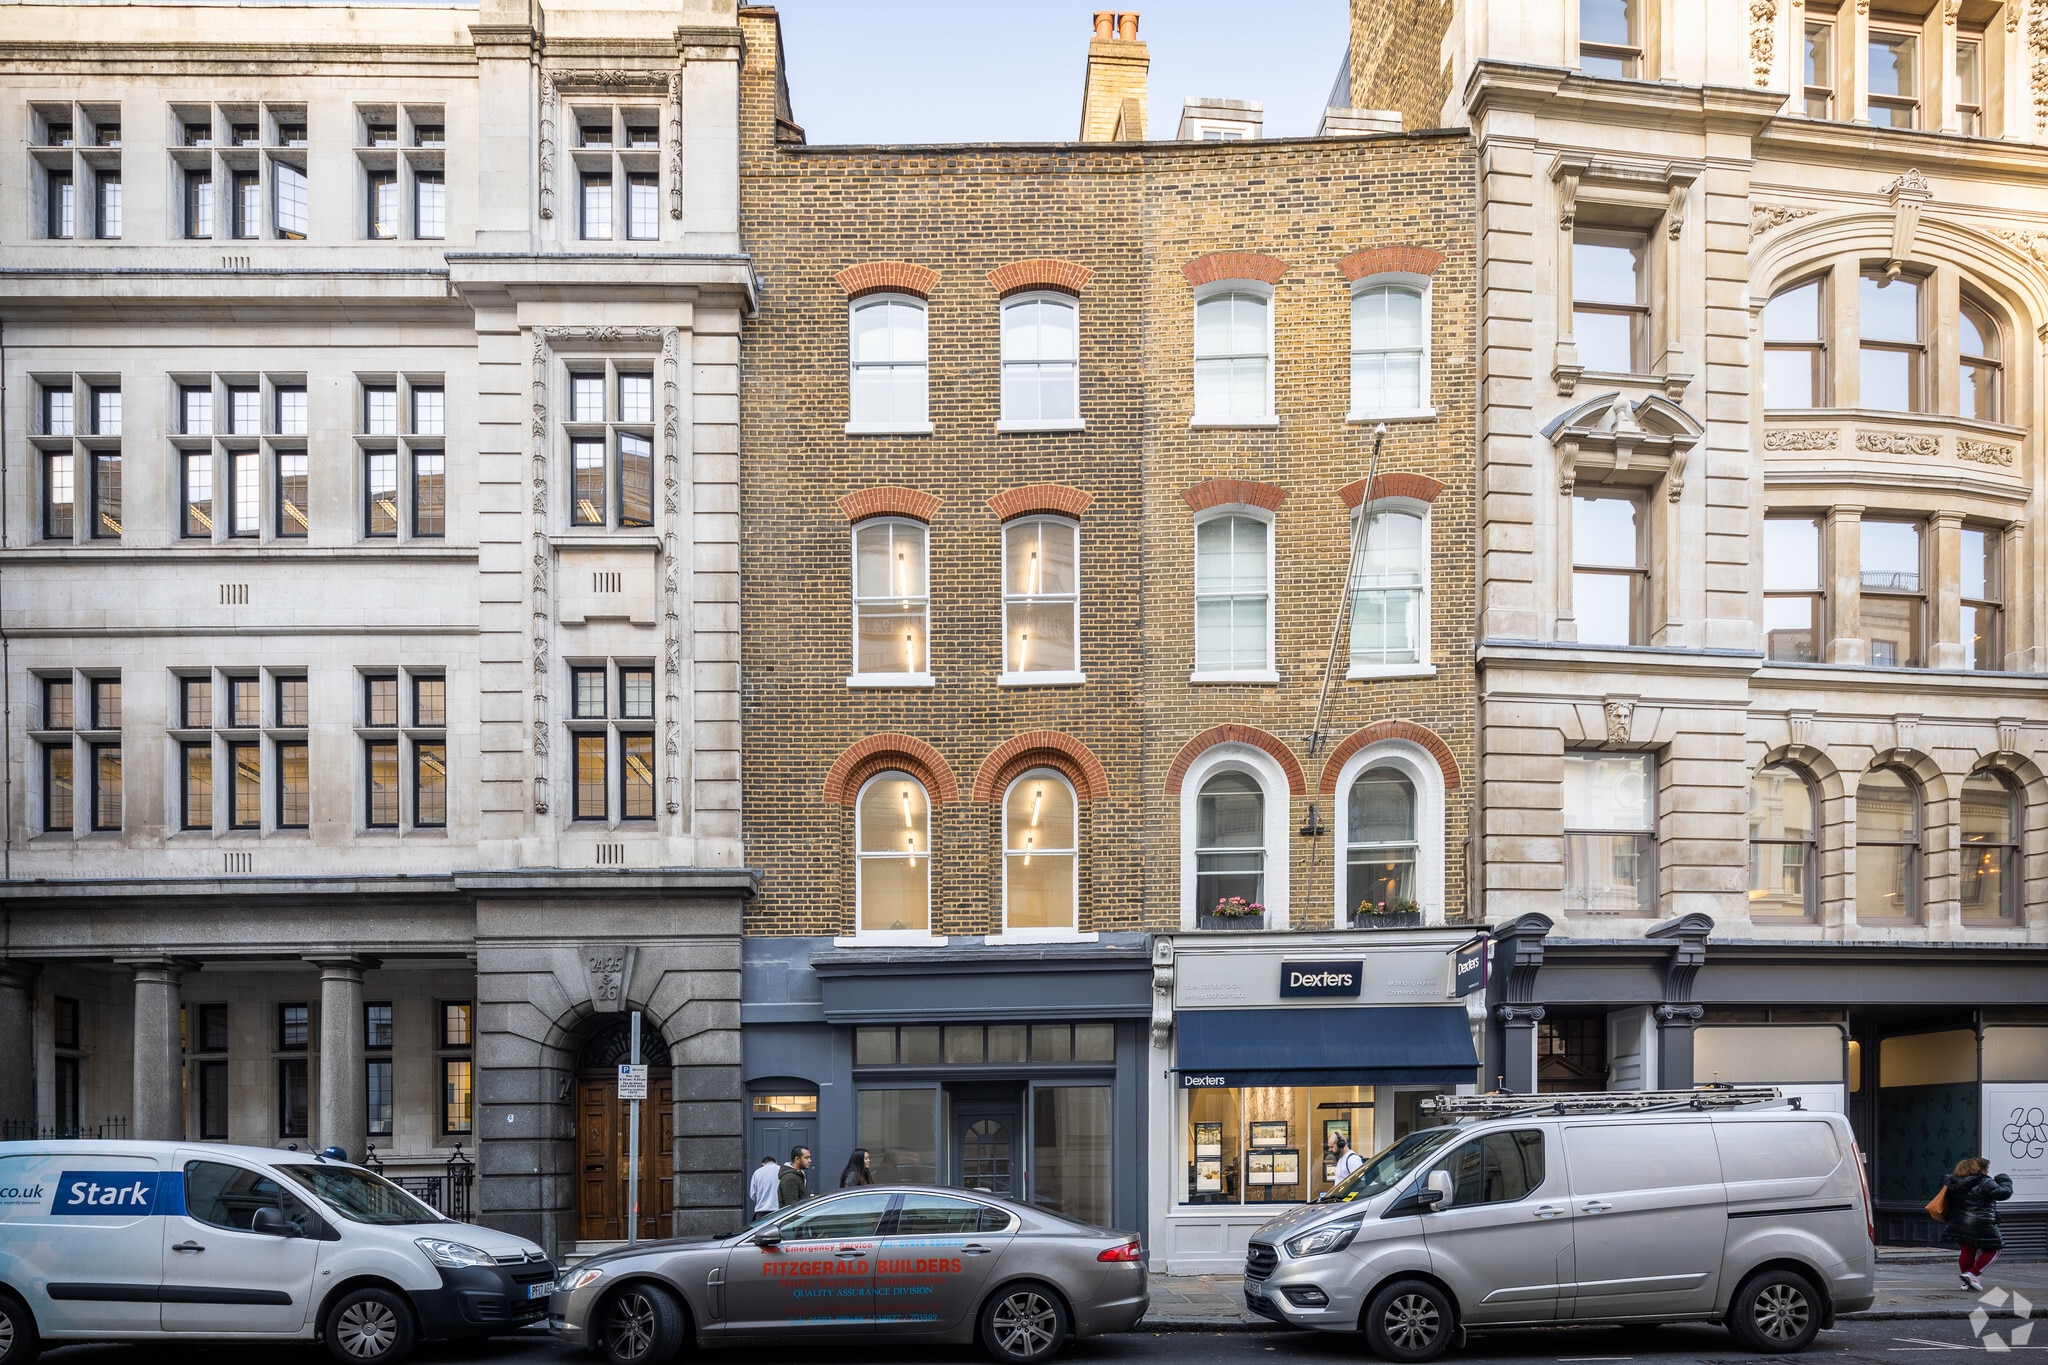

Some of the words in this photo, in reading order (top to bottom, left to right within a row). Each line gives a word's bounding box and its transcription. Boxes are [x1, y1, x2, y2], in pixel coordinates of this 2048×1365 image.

[1290, 971, 1353, 988] Dexters
[598, 985, 618, 1001] 26
[1184, 1075, 1225, 1086] Dexters
[67, 1181, 149, 1206] Stark
[785, 1244, 835, 1253] Emergency
[839, 1242, 873, 1250] Service
[762, 1260, 870, 1277] FITZGERALD
[877, 1258, 962, 1274] BUILDERS
[779, 1278, 813, 1288] Multi
[818, 1277, 865, 1287] Service
[871, 1276, 946, 1286] Contractors
[793, 1289, 834, 1299] QUALITY
[836, 1288, 891, 1297] ASSURANCE
[893, 1287, 934, 1296] DIVISION
